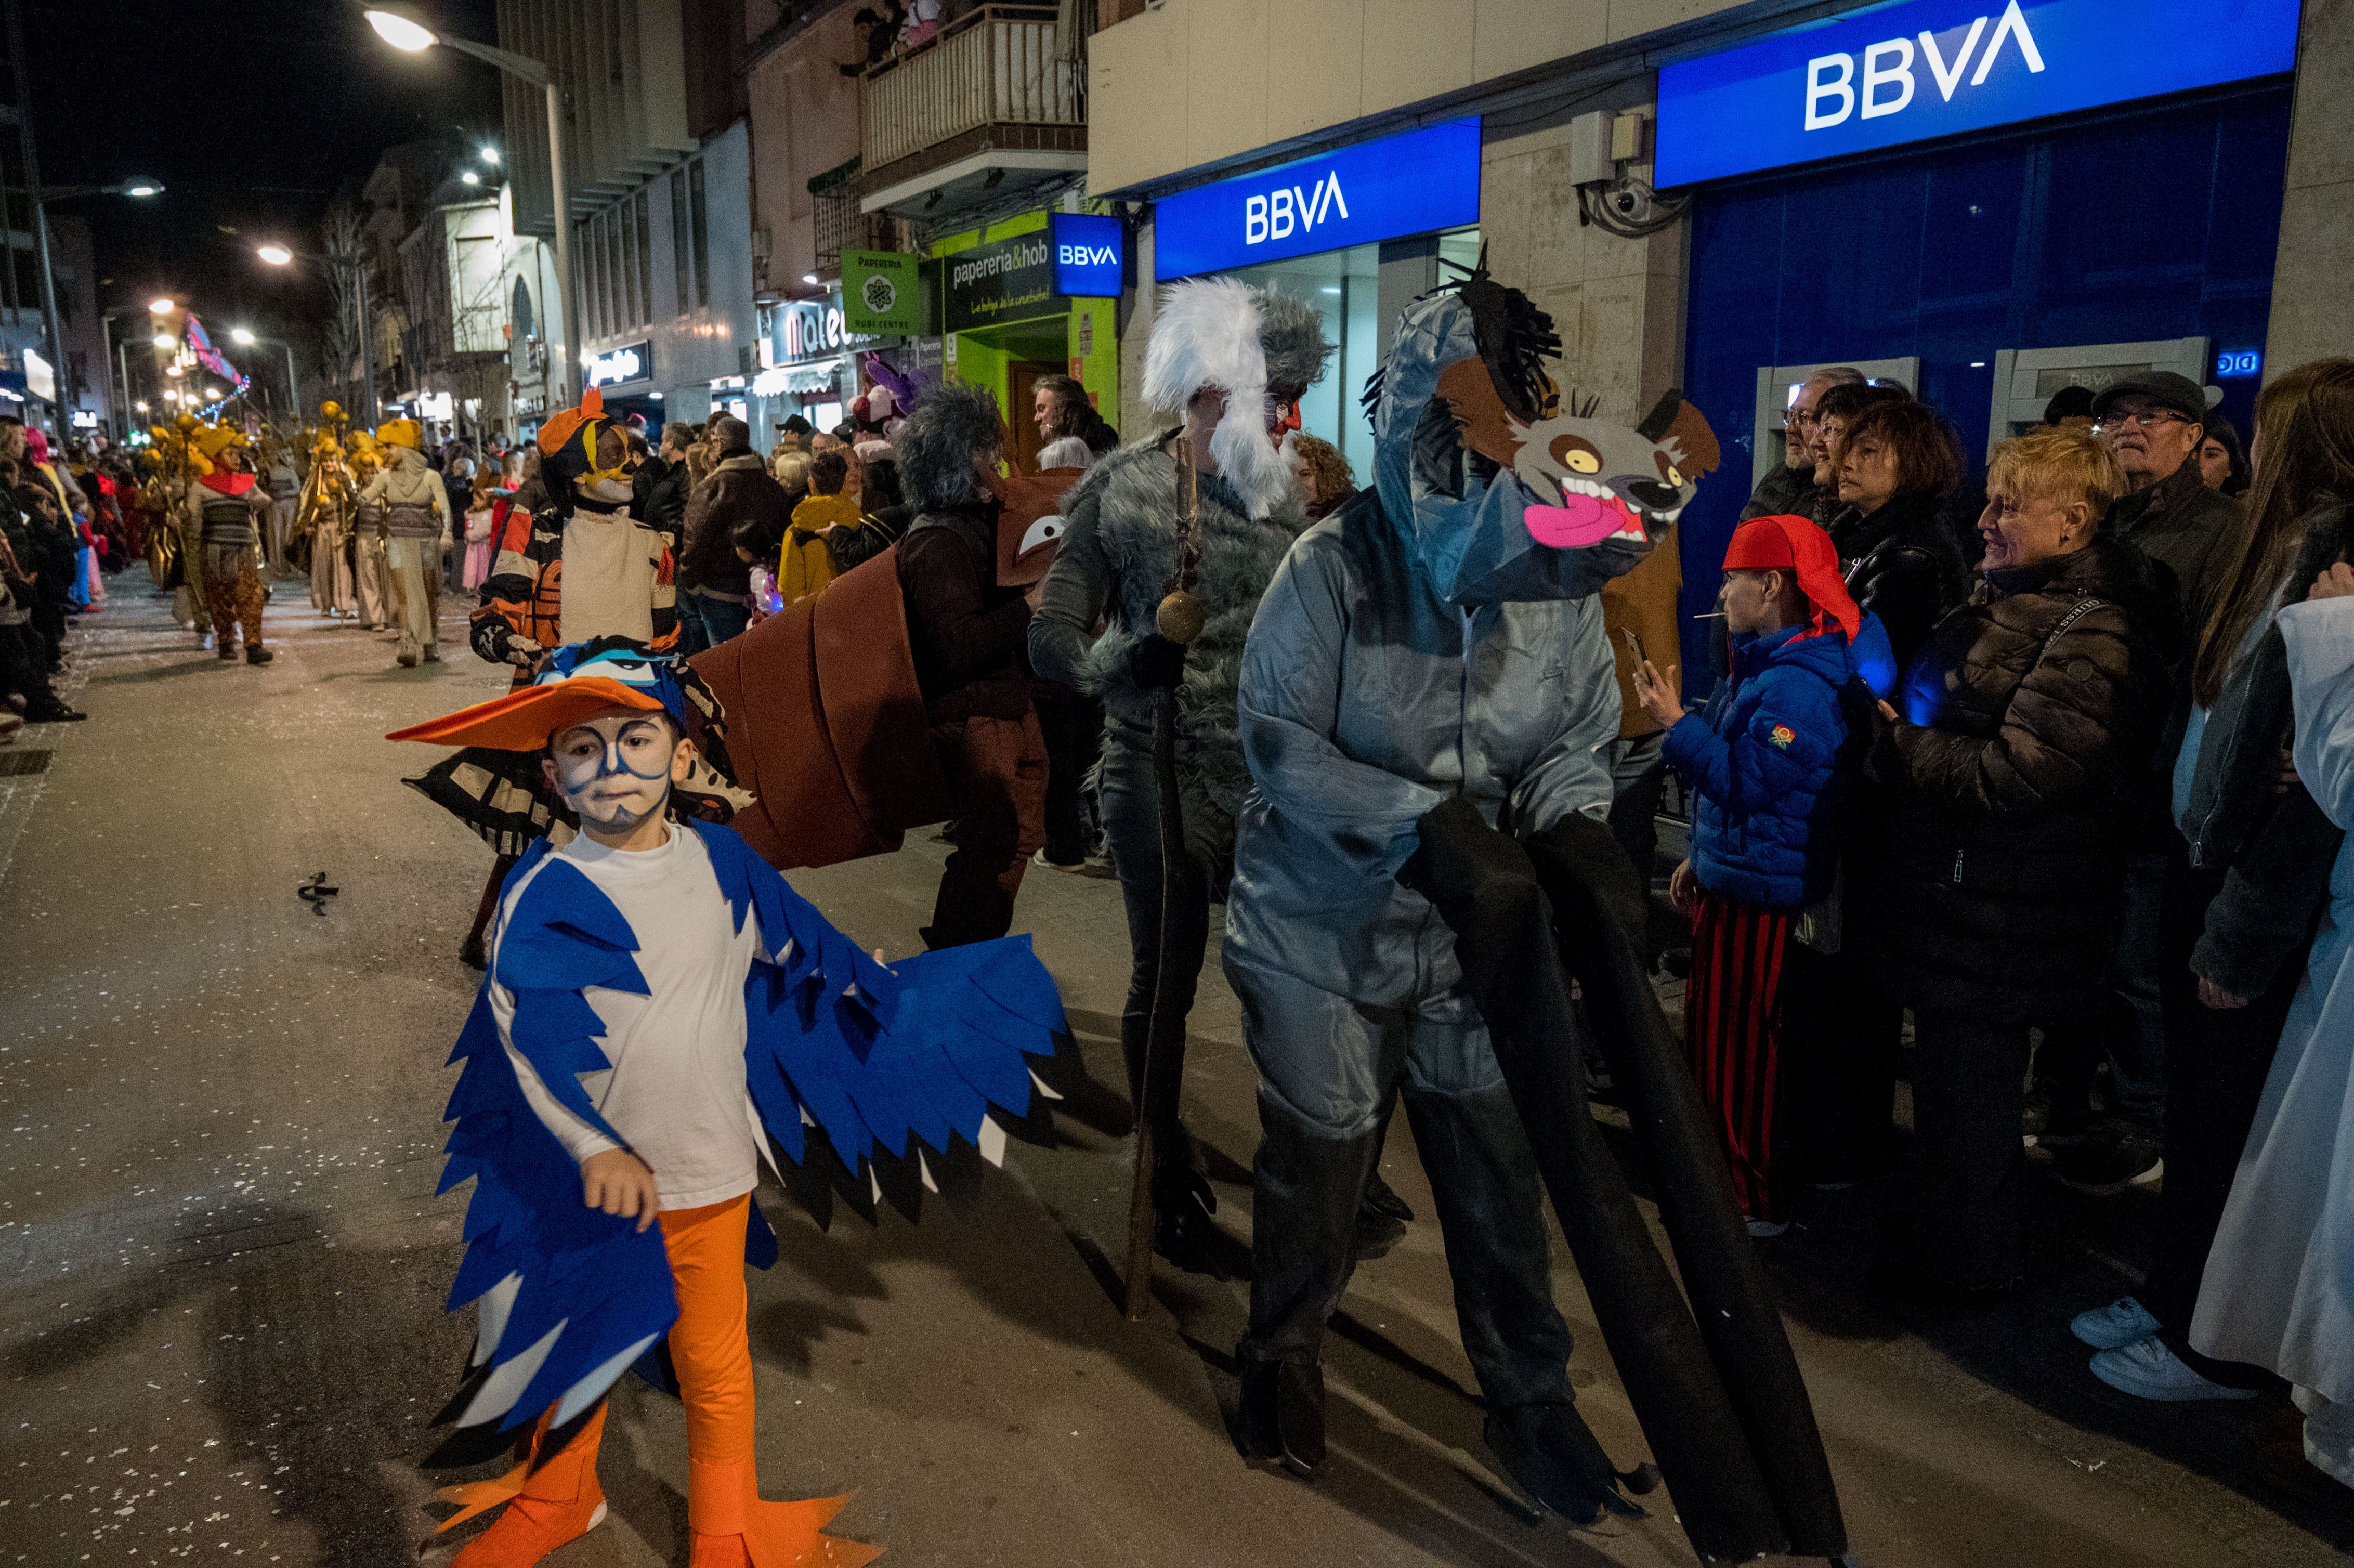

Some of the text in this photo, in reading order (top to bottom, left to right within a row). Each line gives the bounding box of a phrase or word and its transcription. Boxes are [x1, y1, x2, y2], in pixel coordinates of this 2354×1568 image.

[1805, 0, 2044, 130] BBVA
[1246, 171, 1348, 244] BBVA
[1060, 246, 1117, 265] BBVA
[2069, 373, 2114, 387] BBVA
[2060, 599, 2100, 627] GUESS
